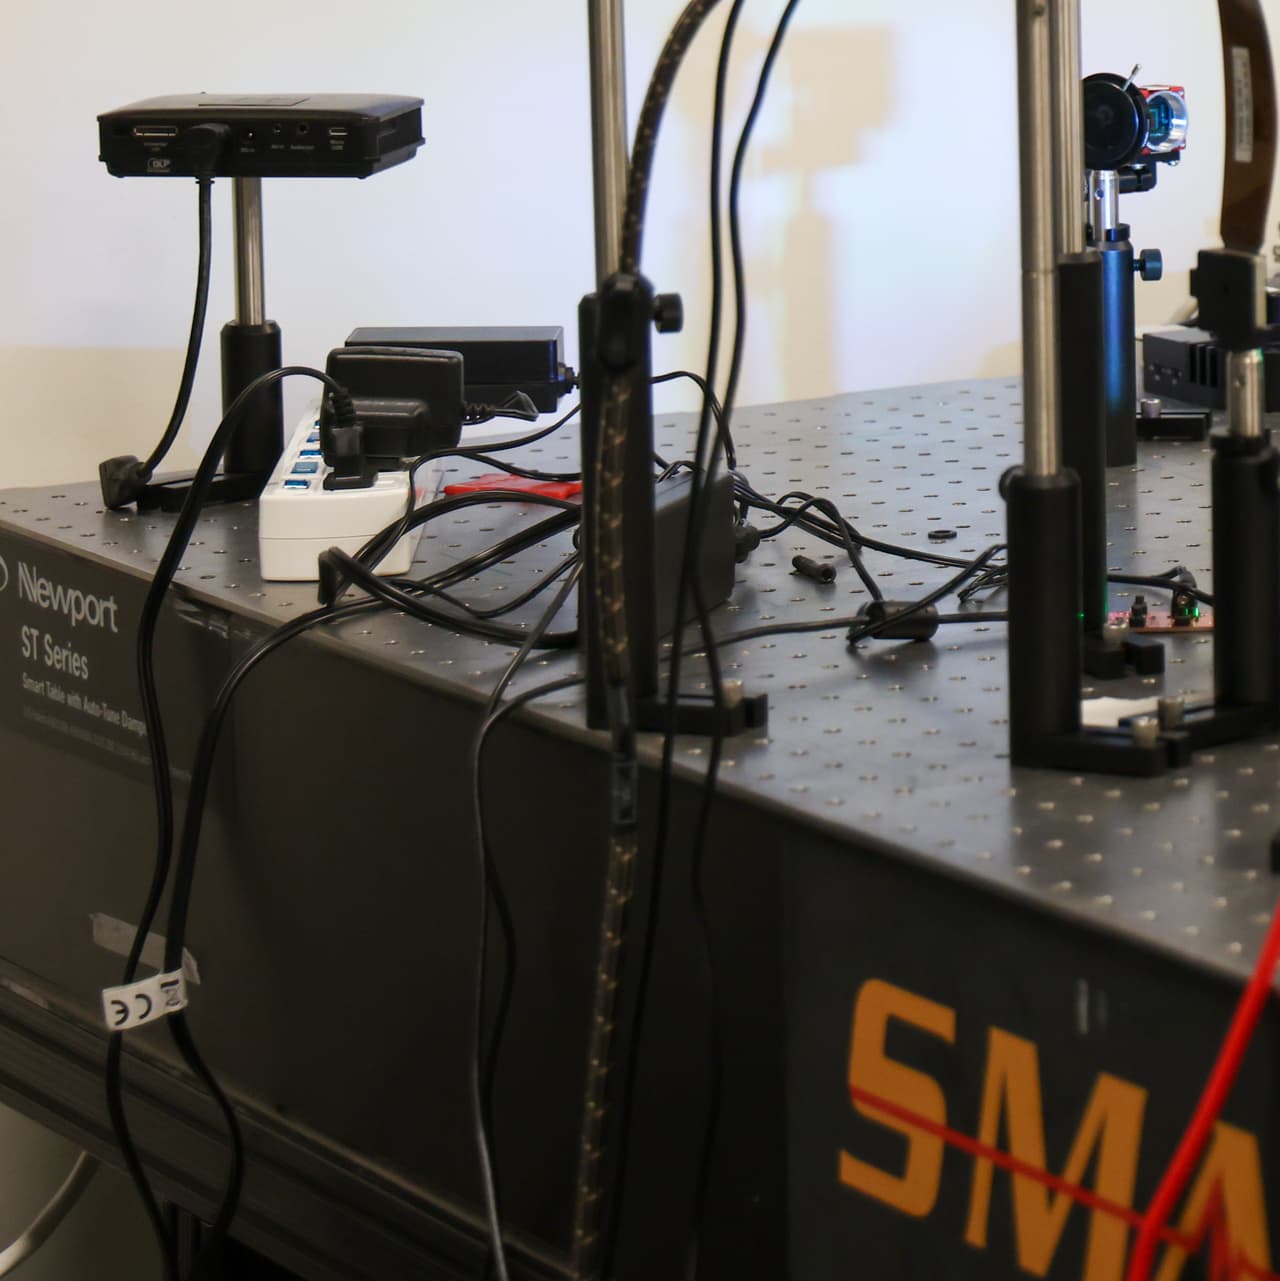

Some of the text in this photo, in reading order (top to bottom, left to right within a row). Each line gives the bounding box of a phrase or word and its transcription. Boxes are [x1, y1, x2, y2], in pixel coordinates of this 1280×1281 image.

[18, 561, 118, 632] Newport
[21, 625, 88, 680] ST Series
